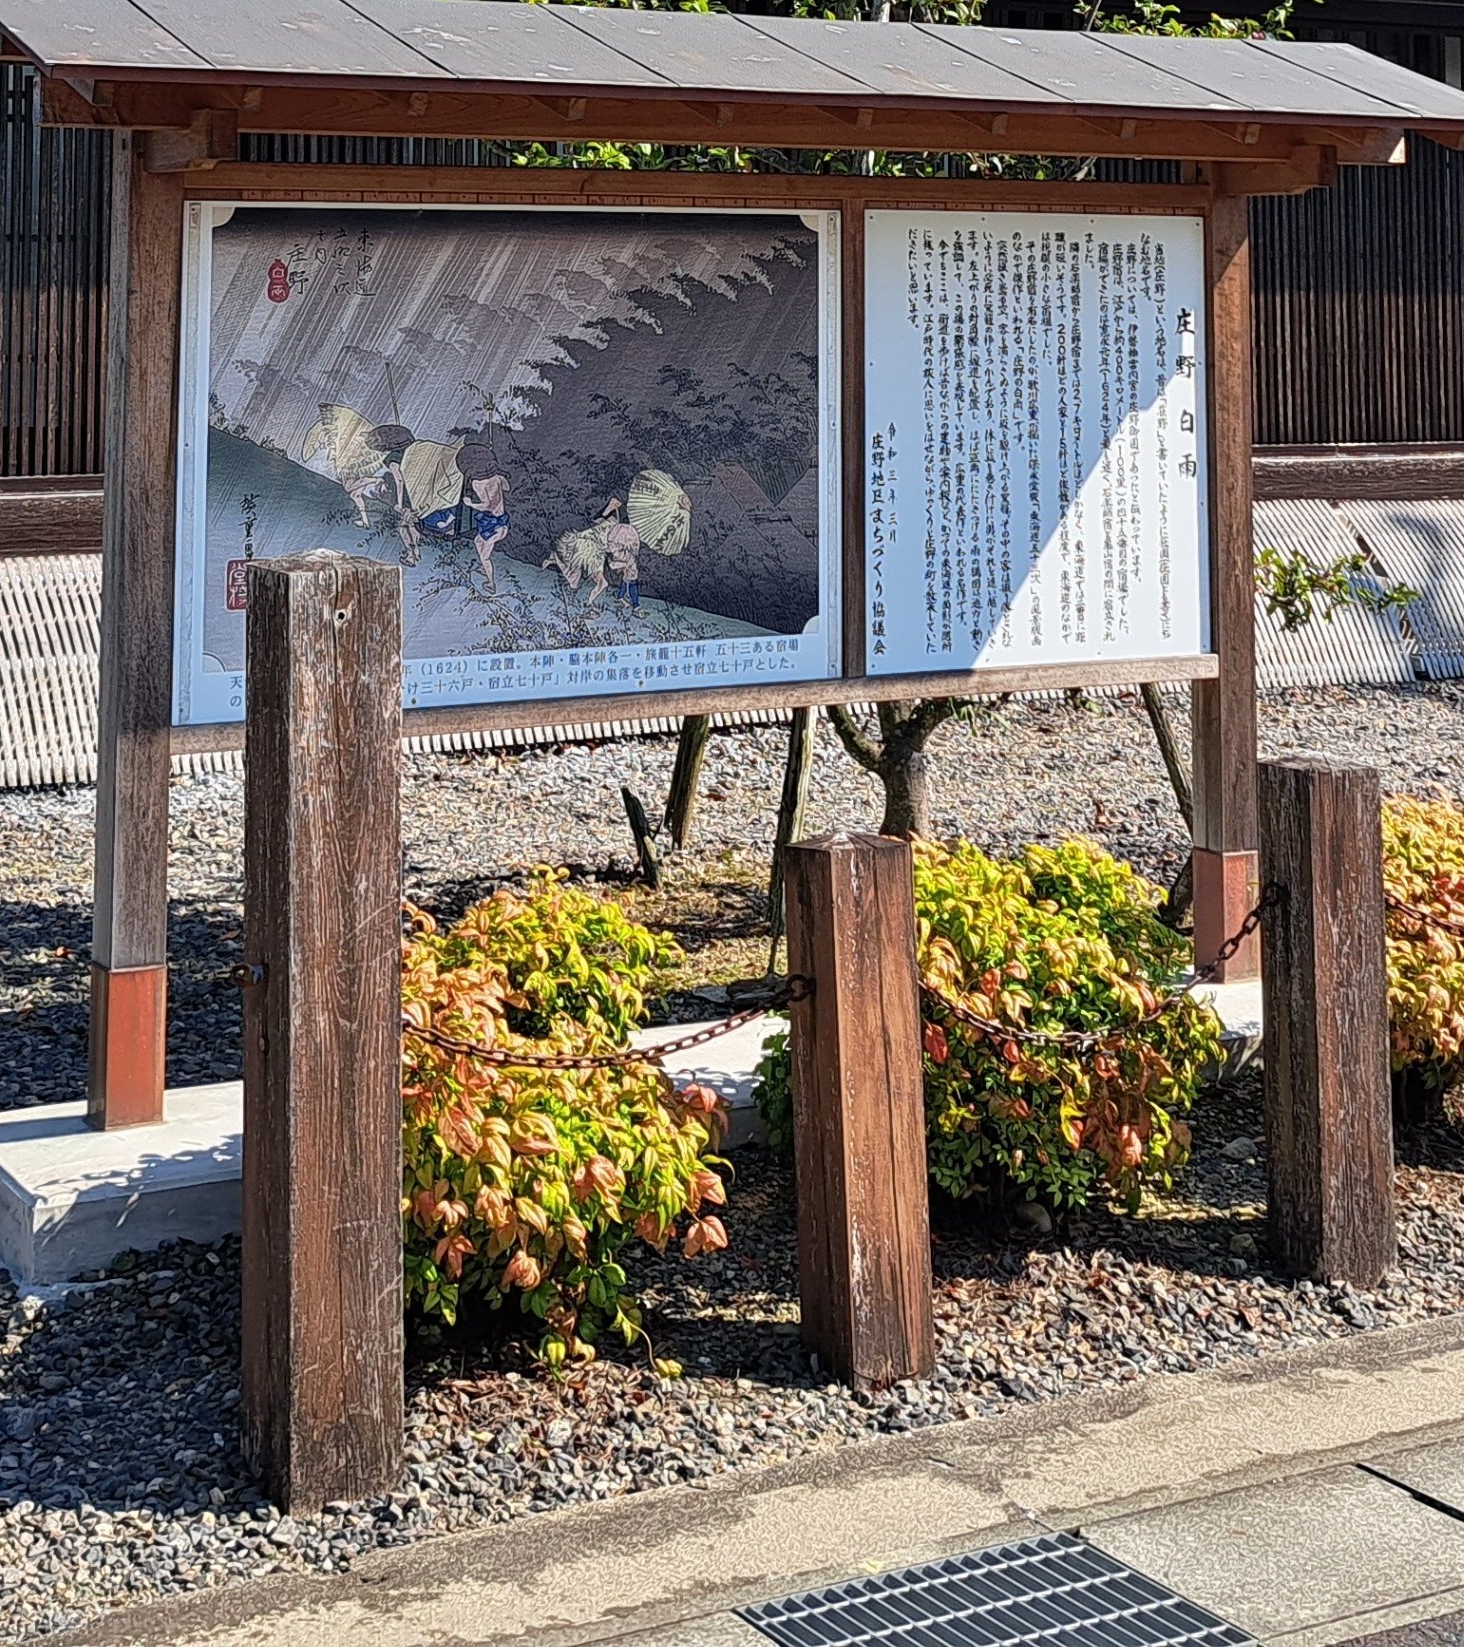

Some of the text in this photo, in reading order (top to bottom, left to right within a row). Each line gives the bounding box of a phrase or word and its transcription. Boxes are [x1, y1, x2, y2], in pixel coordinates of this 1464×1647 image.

[286, 243, 309, 295] 庄野
[1084, 232, 1095, 269] ました。
[870, 432, 887, 656] 庄野地区まちづくり協議会
[229, 675, 243, 690] 天
[229, 695, 243, 708] の
